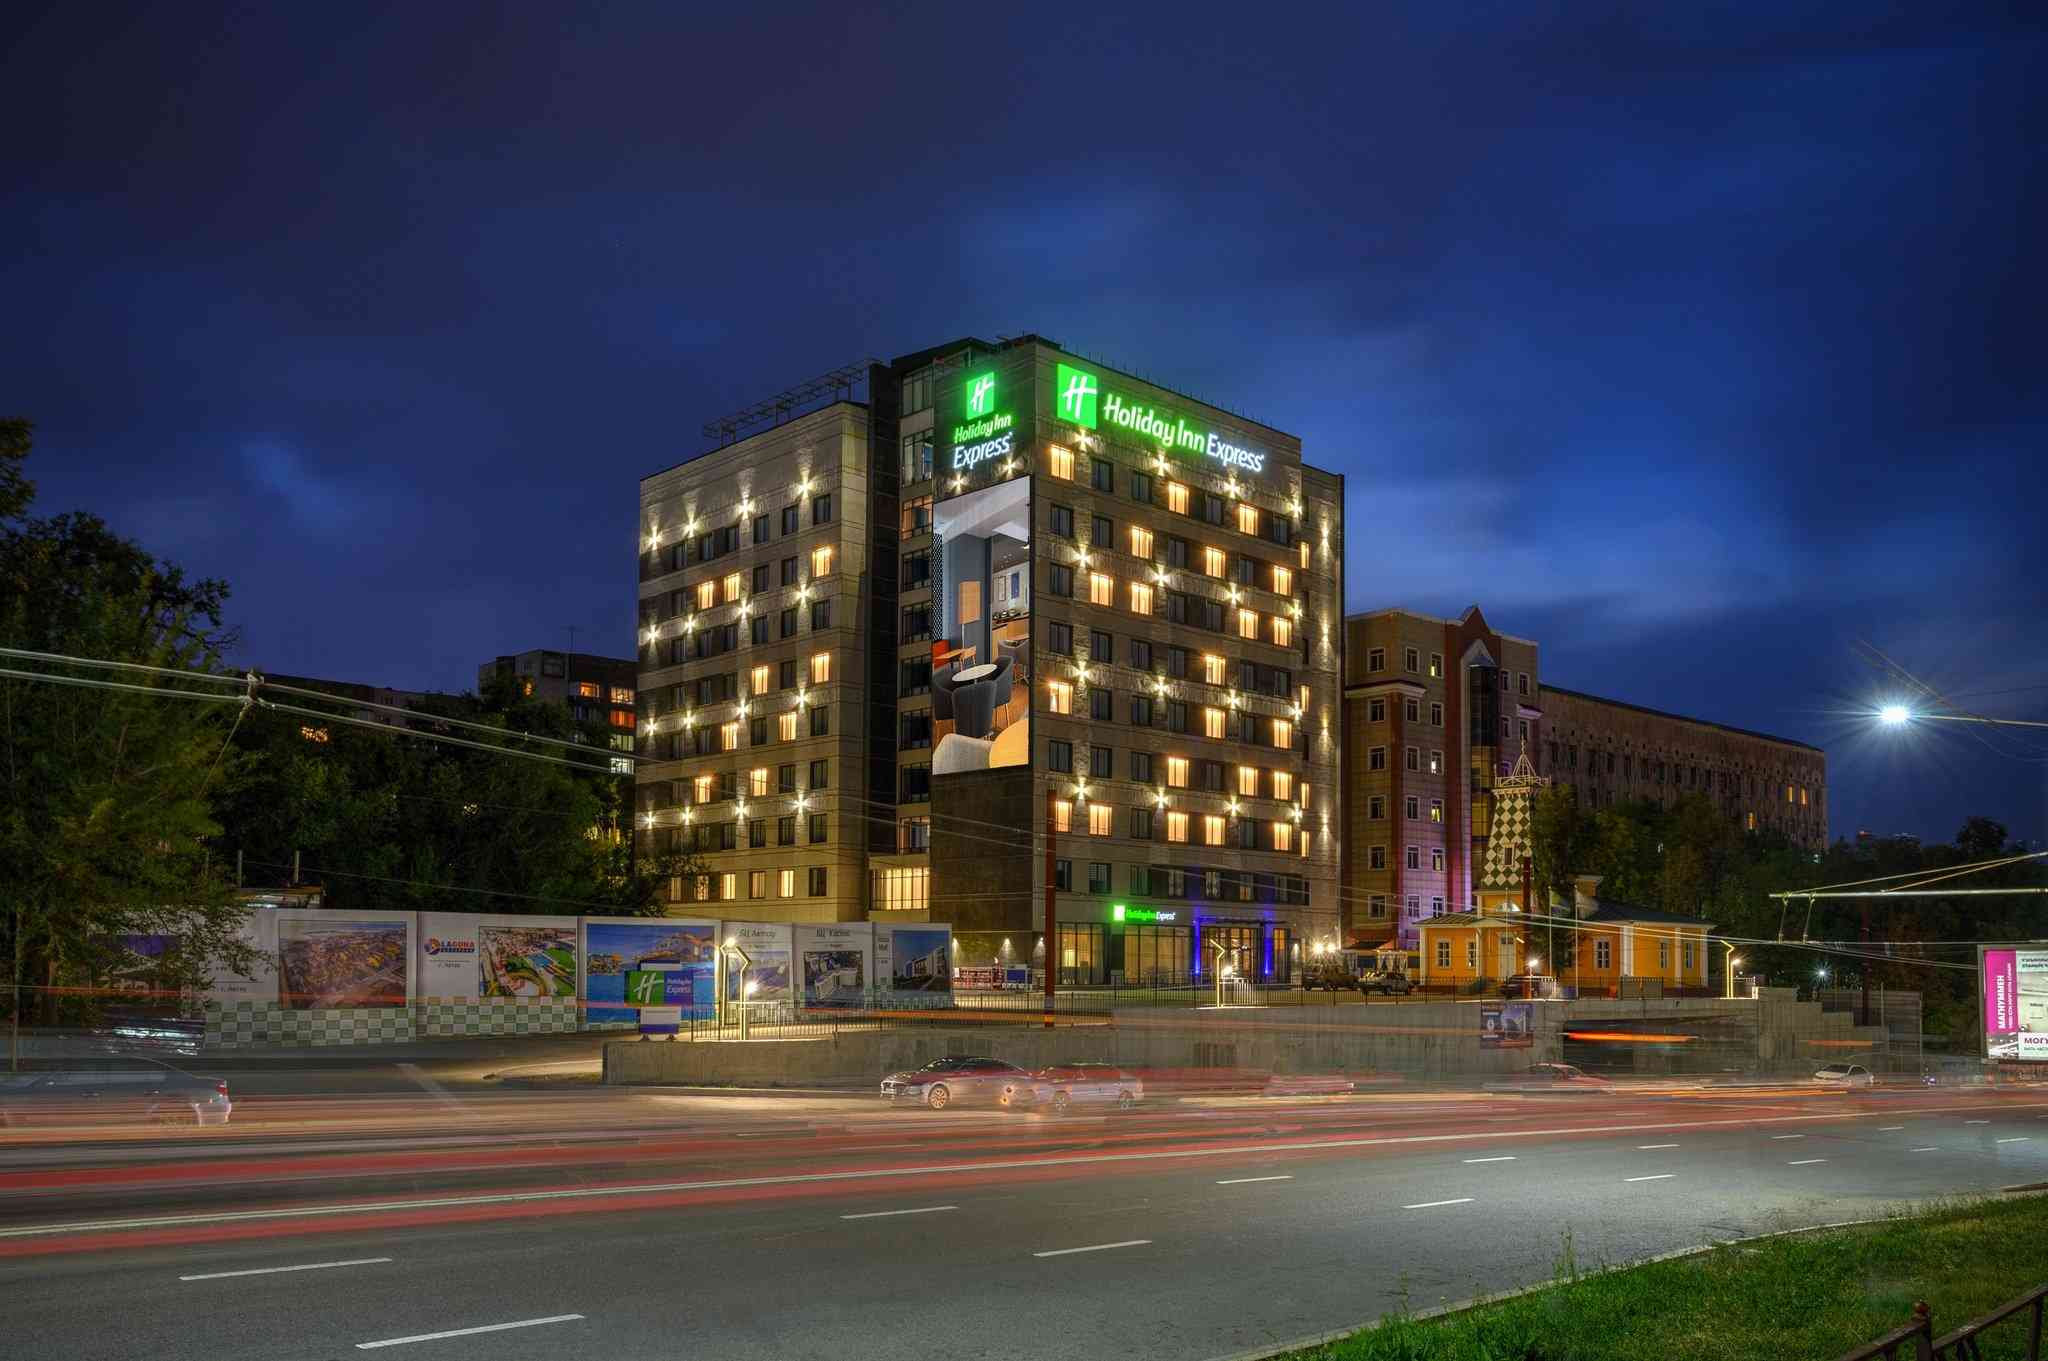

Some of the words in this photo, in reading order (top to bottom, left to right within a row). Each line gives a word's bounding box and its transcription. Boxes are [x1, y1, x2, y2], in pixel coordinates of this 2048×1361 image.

[954, 419, 994, 444] Holiday
[994, 413, 1012, 431] Inn
[1103, 393, 1177, 447] Holiday
[1177, 420, 1205, 454] Inn
[1206, 432, 1264, 473] Express
[953, 432, 1012, 470] Express
